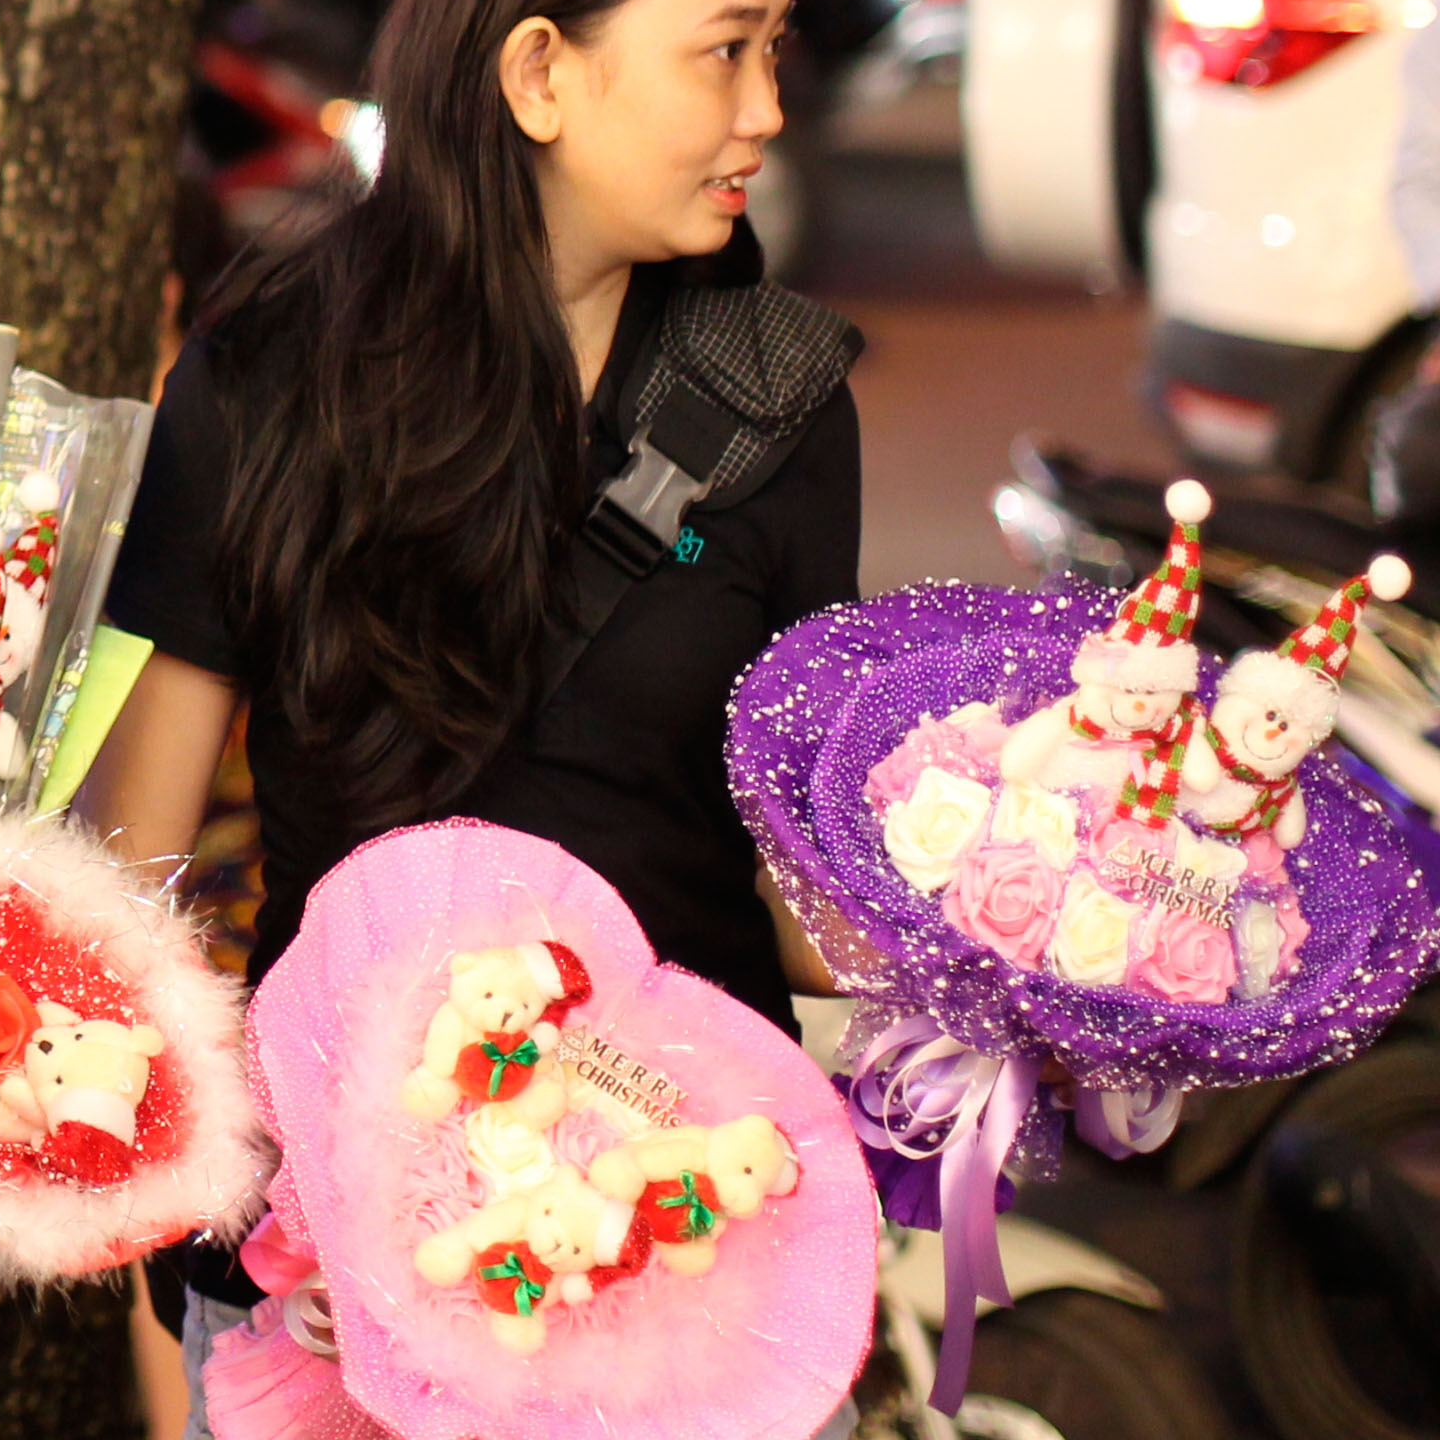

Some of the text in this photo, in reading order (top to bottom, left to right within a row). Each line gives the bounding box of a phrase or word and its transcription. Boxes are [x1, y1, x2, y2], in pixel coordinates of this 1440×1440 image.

[1129, 873, 1234, 931] CHRISTMAS
[1137, 849, 1236, 905] MERRY
[576, 1061, 681, 1129] CHRISTMAS
[587, 1038, 688, 1108] MERRY
